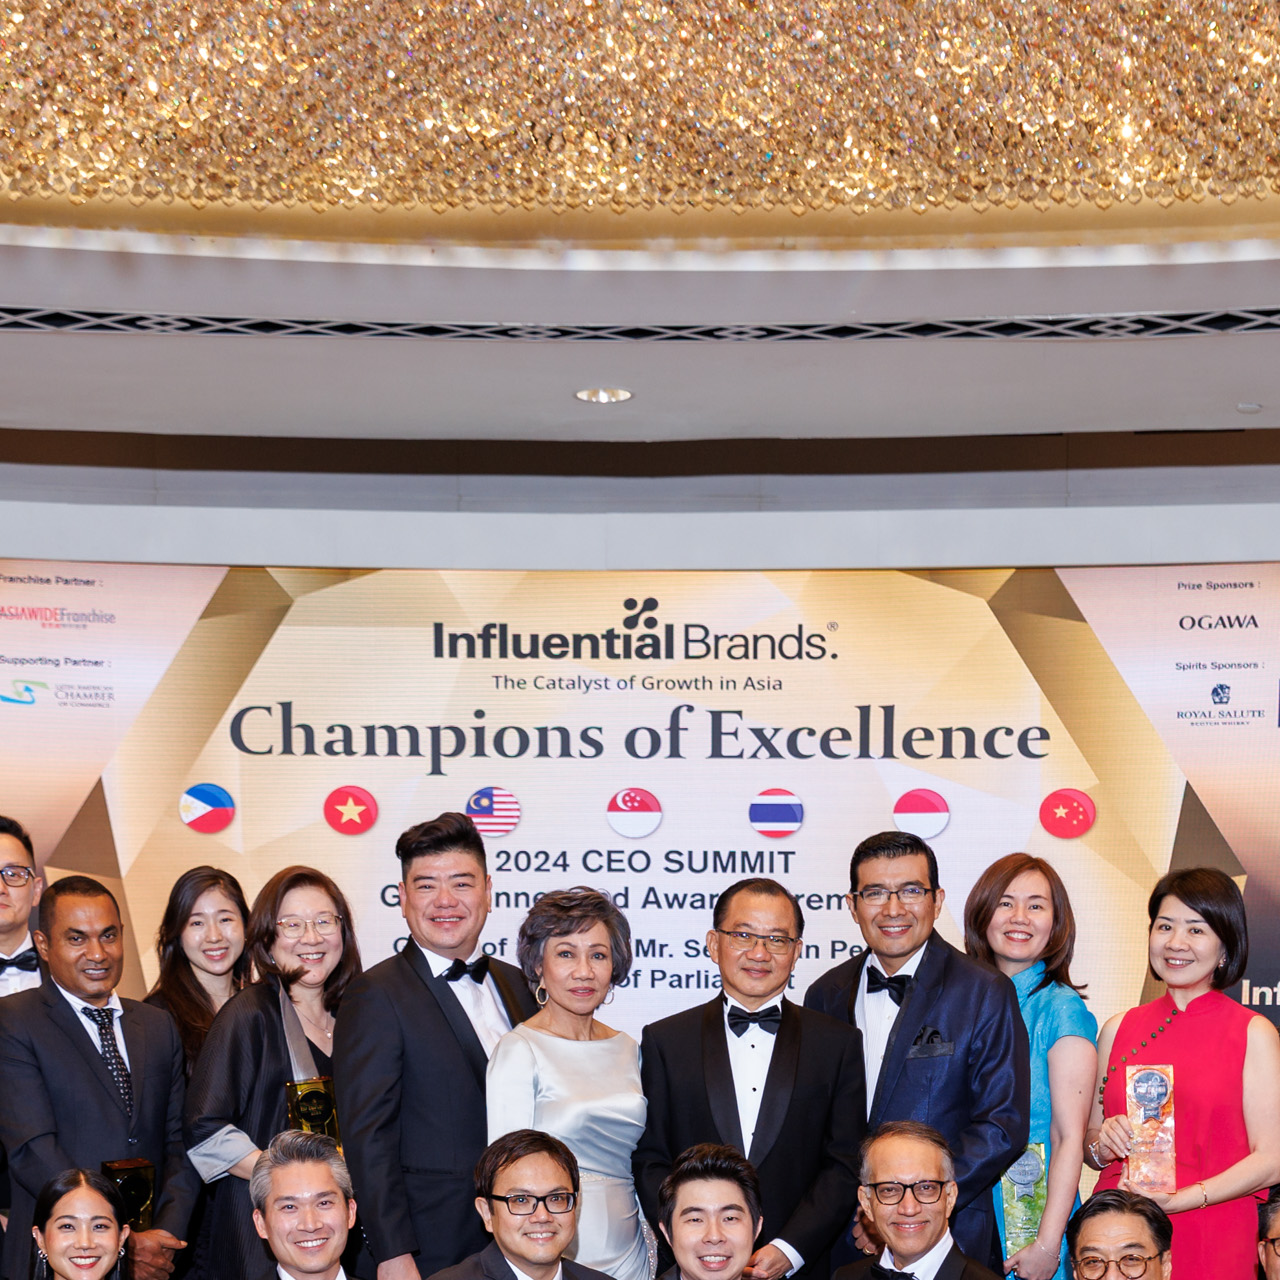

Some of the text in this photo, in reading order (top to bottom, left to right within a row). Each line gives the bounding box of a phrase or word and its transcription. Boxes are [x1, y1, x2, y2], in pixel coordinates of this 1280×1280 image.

[54, 576, 96, 587] Partner
[1177, 581, 1203, 591] Prize
[1206, 580, 1255, 591] Sponsors
[1179, 614, 1260, 631] OGAWA
[433, 621, 674, 661] Influential
[63, 657, 104, 667] Partner
[1175, 661, 1207, 671] Spirits
[1211, 661, 1259, 671] Sponsors
[491, 674, 783, 694] The Catalyst of Growth in Asia
[1176, 709, 1266, 719] ROYAL SALUTE
[229, 701, 1051, 776] Champions of Excellence
[495, 849, 796, 874] 2024 CEO SUMMIT
[482, 938, 509, 958] of
[634, 938, 674, 958] Mr.
